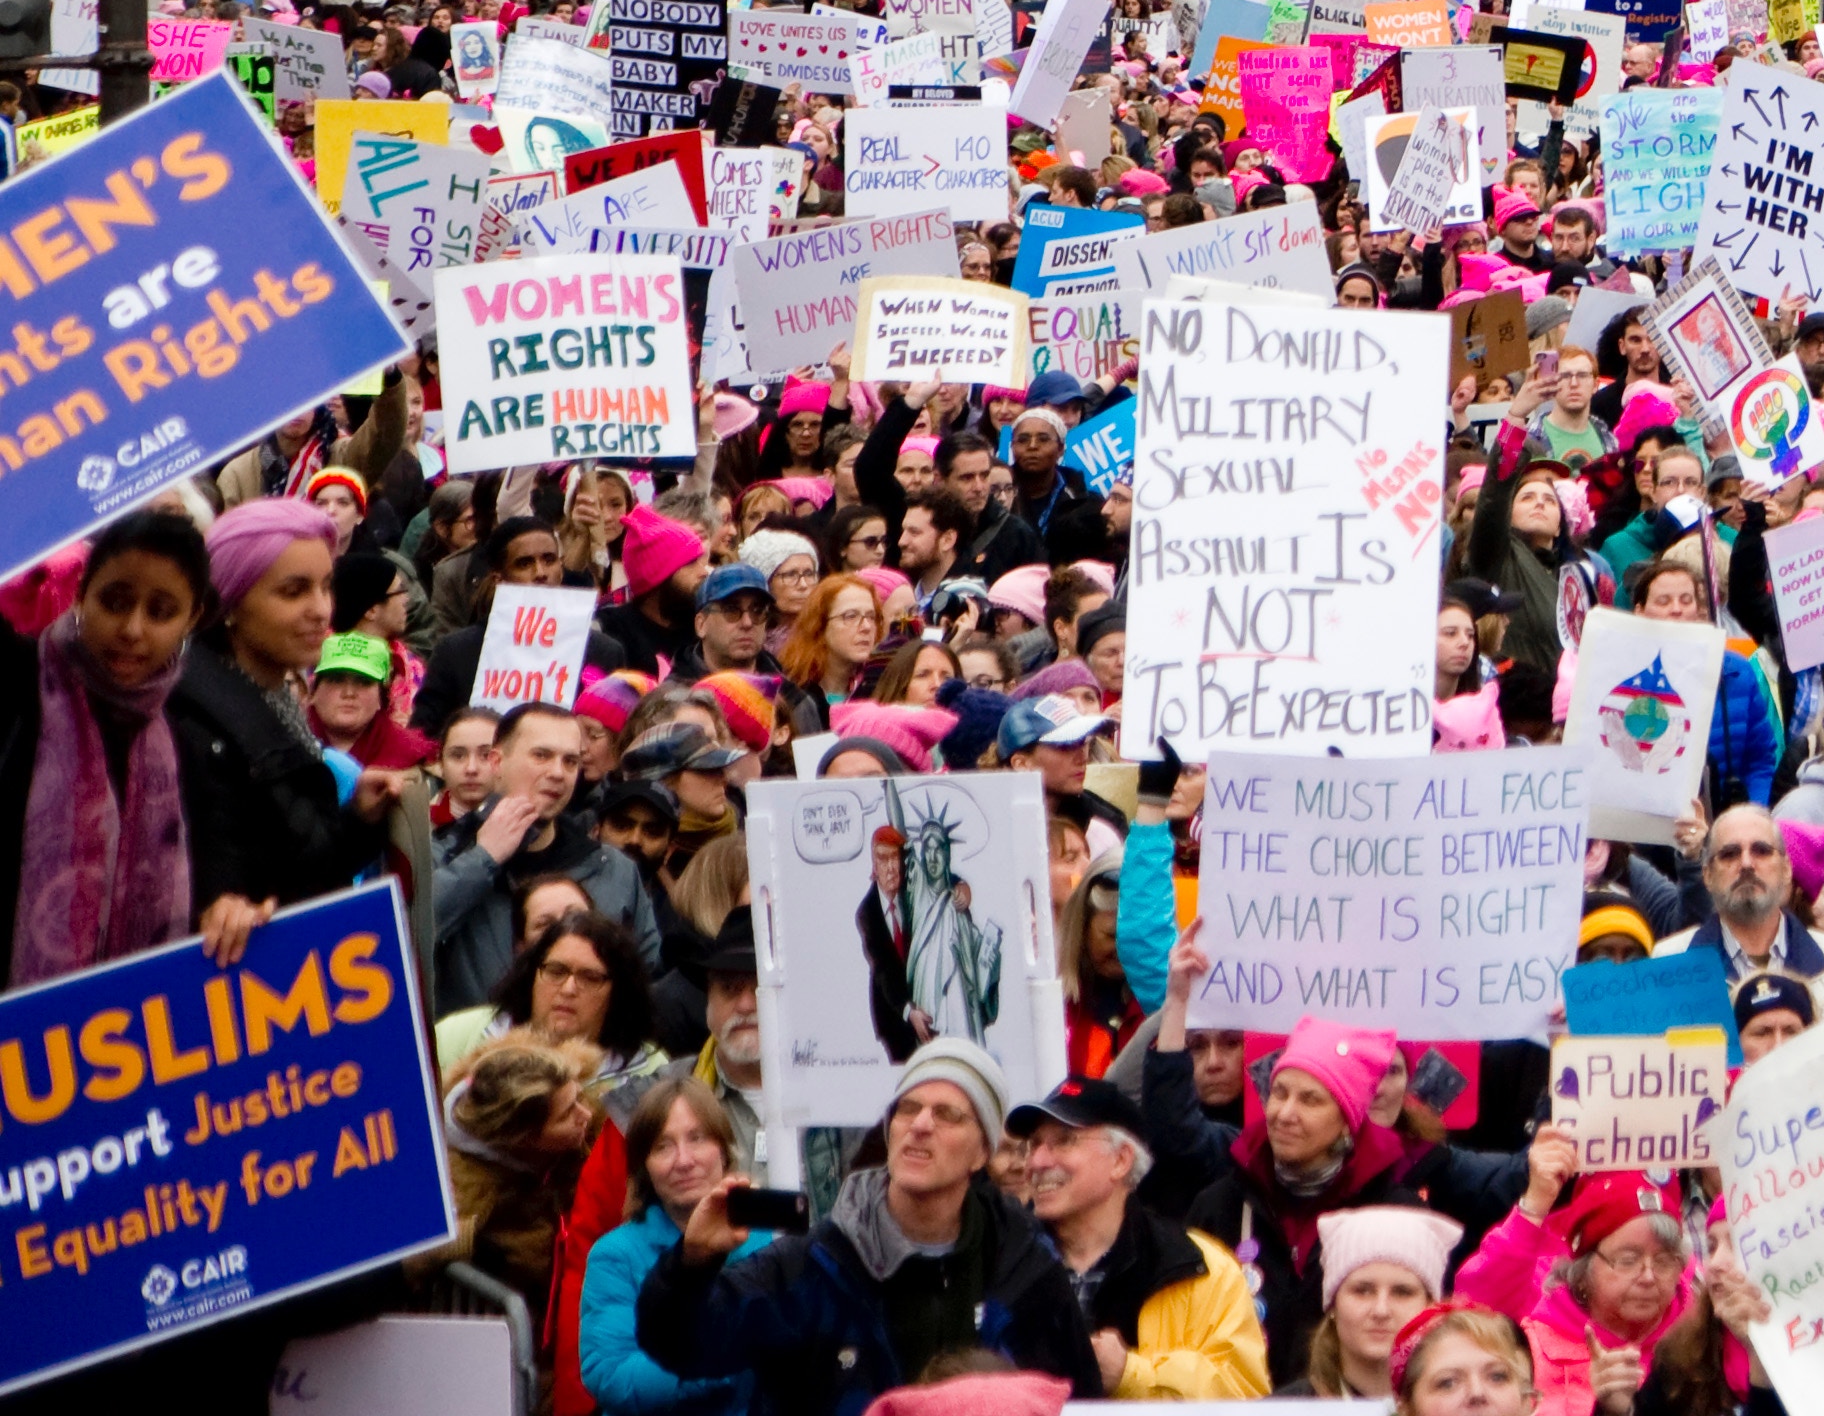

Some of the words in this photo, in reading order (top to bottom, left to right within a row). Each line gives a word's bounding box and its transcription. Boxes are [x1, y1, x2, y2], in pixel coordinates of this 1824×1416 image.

[610, 28, 671, 54] PUTS
[684, 34, 725, 57] MY
[612, 59, 676, 84] BABY
[612, 91, 695, 116] MAKER
[860, 137, 908, 162] REAL
[955, 136, 990, 160] 140
[1766, 139, 1814, 176] I'M
[847, 170, 925, 191] CHARACTER
[935, 168, 1009, 191] CHARACTERS
[1744, 162, 1824, 213] WITH
[1746, 200, 1808, 240] HER
[102, 246, 221, 329] are
[464, 274, 681, 326] WOMEN'S
[104, 261, 335, 404] Rights
[488, 325, 657, 380] RIGHTS
[1225, 305, 1398, 375] DONALD,
[457, 395, 546, 442] ARE
[552, 388, 670, 425] HUMAN
[1141, 368, 1372, 445] MILITARY
[551, 423, 662, 456] RIGHTS
[1137, 449, 1313, 510] SEXUAL
[1135, 518, 1302, 584] ASSAULT
[1316, 513, 1395, 584] IS
[512, 605, 557, 649] We
[1201, 587, 1335, 654] NOT
[482, 663, 568, 703] won't
[1210, 777, 1270, 814] WE
[1294, 780, 1397, 822] MUST
[1413, 780, 1479, 818] ALL
[1500, 770, 1584, 811] FACE
[1213, 831, 1288, 873] THE
[1310, 834, 1424, 877] CHOICE
[1441, 824, 1580, 874] BETWEEN
[1227, 896, 1352, 941] WHAT
[1379, 897, 1419, 941] IS
[1440, 885, 1556, 937] RIGHT
[1202, 960, 1282, 1003] AND
[1296, 967, 1396, 1008] WHAT
[1420, 968, 1460, 1005] IS
[1479, 956, 1568, 1003] EASY
[2, 932, 394, 1125] USLIMS
[185, 1061, 362, 1146] Justice
[15, 1178, 227, 1280] Equality
[245, 1149, 318, 1208] for
[332, 1111, 398, 1180] All
[181, 1247, 247, 1289] CAIR
[146, 1282, 252, 1332] www.cair.com
